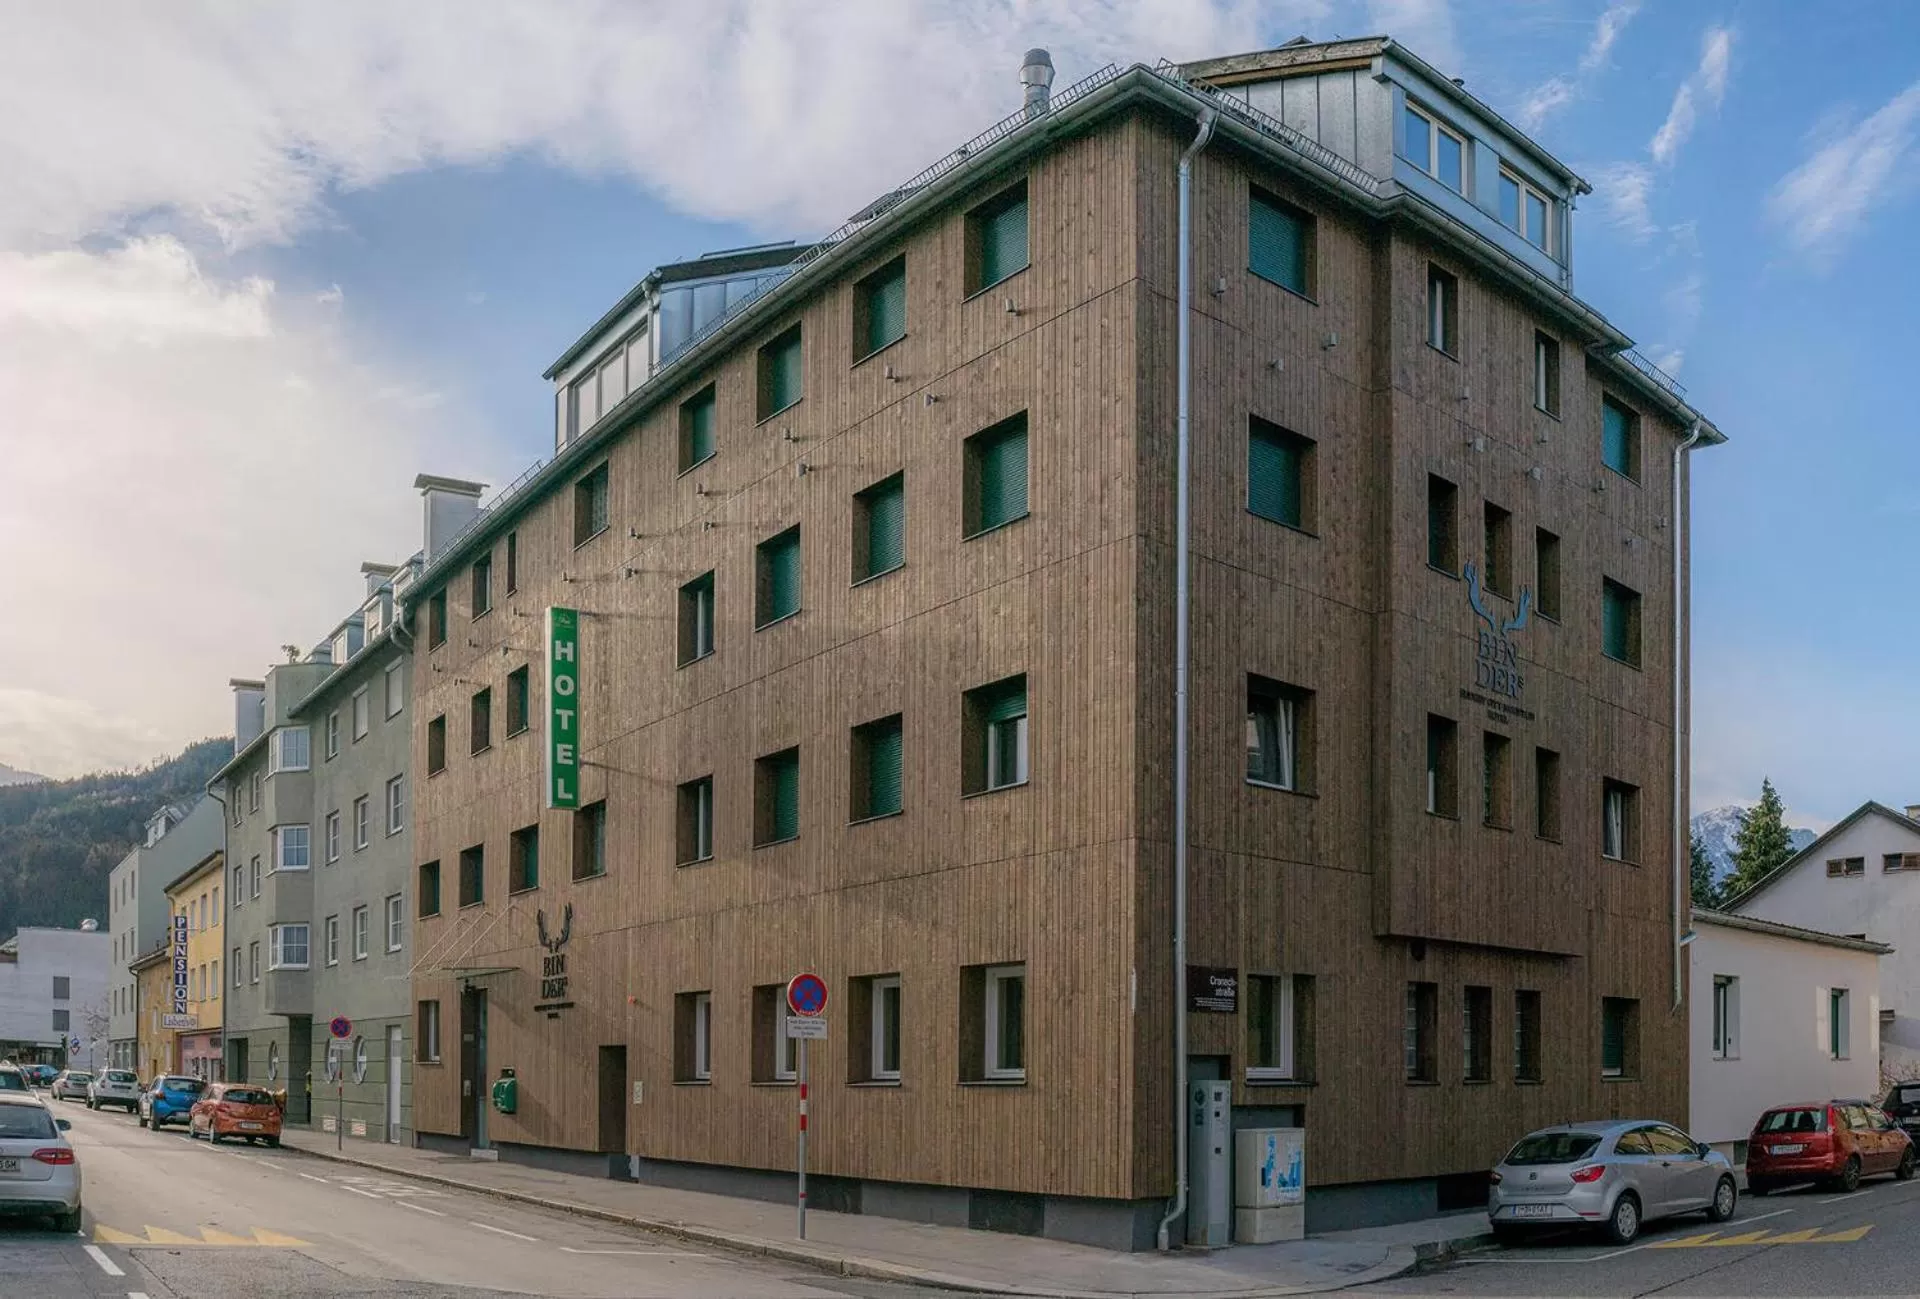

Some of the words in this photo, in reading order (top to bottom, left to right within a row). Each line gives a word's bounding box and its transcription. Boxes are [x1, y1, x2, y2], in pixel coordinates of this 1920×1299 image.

[554, 639, 575, 800] HOTEL
[175, 917, 187, 1014] PENSION
[543, 953, 566, 977] BIN
